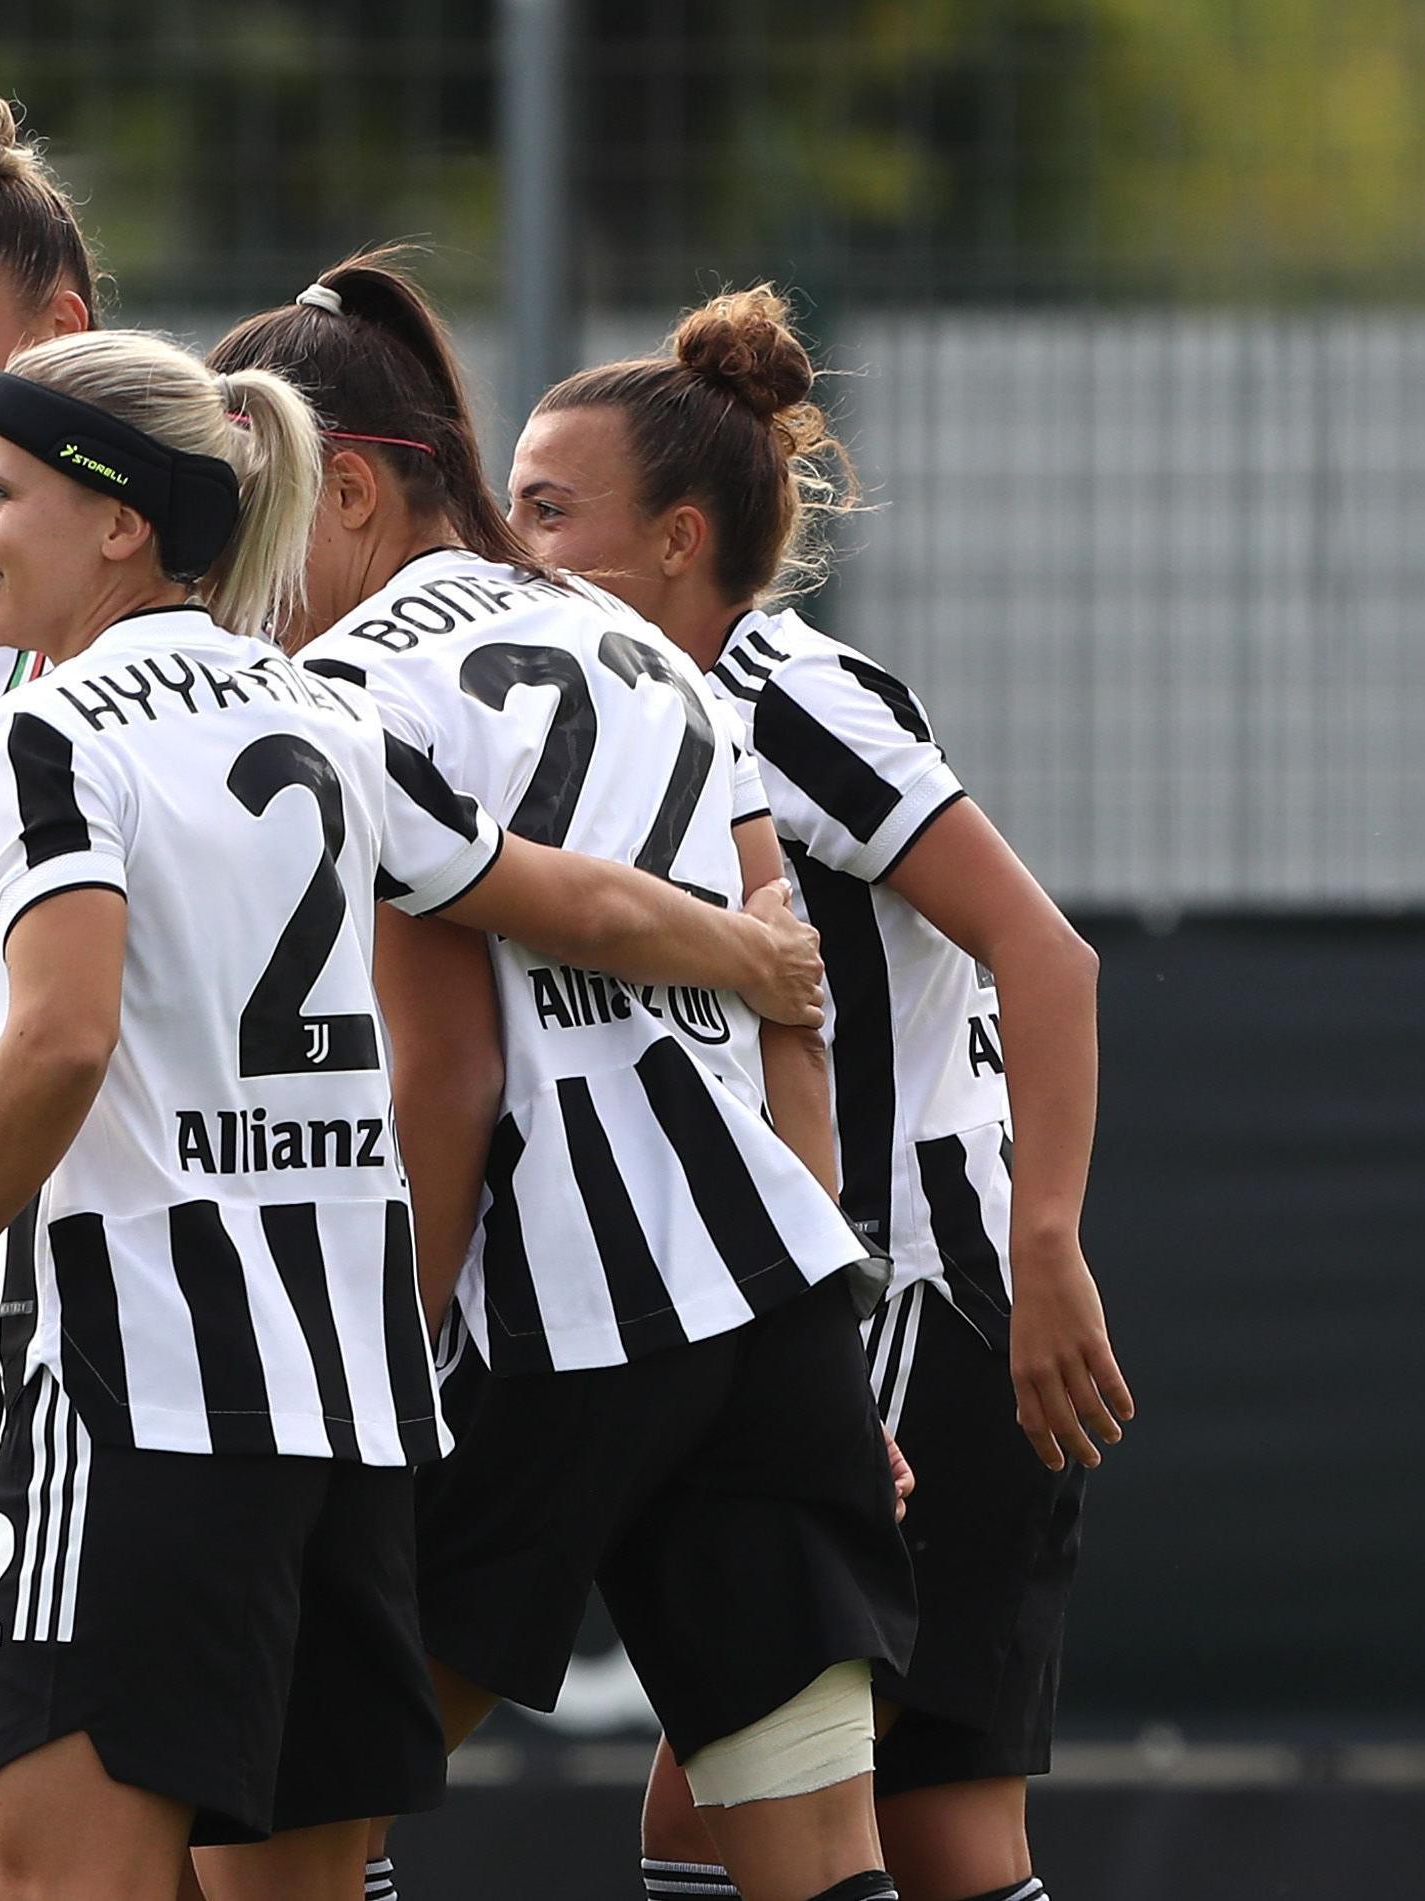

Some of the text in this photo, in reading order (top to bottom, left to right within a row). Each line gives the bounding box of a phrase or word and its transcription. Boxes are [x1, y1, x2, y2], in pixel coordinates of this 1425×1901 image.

[72, 454, 129, 485] STORELLI
[460, 631, 728, 908] 22
[227, 733, 381, 1079] 2
[175, 1107, 385, 1175] Allianz
